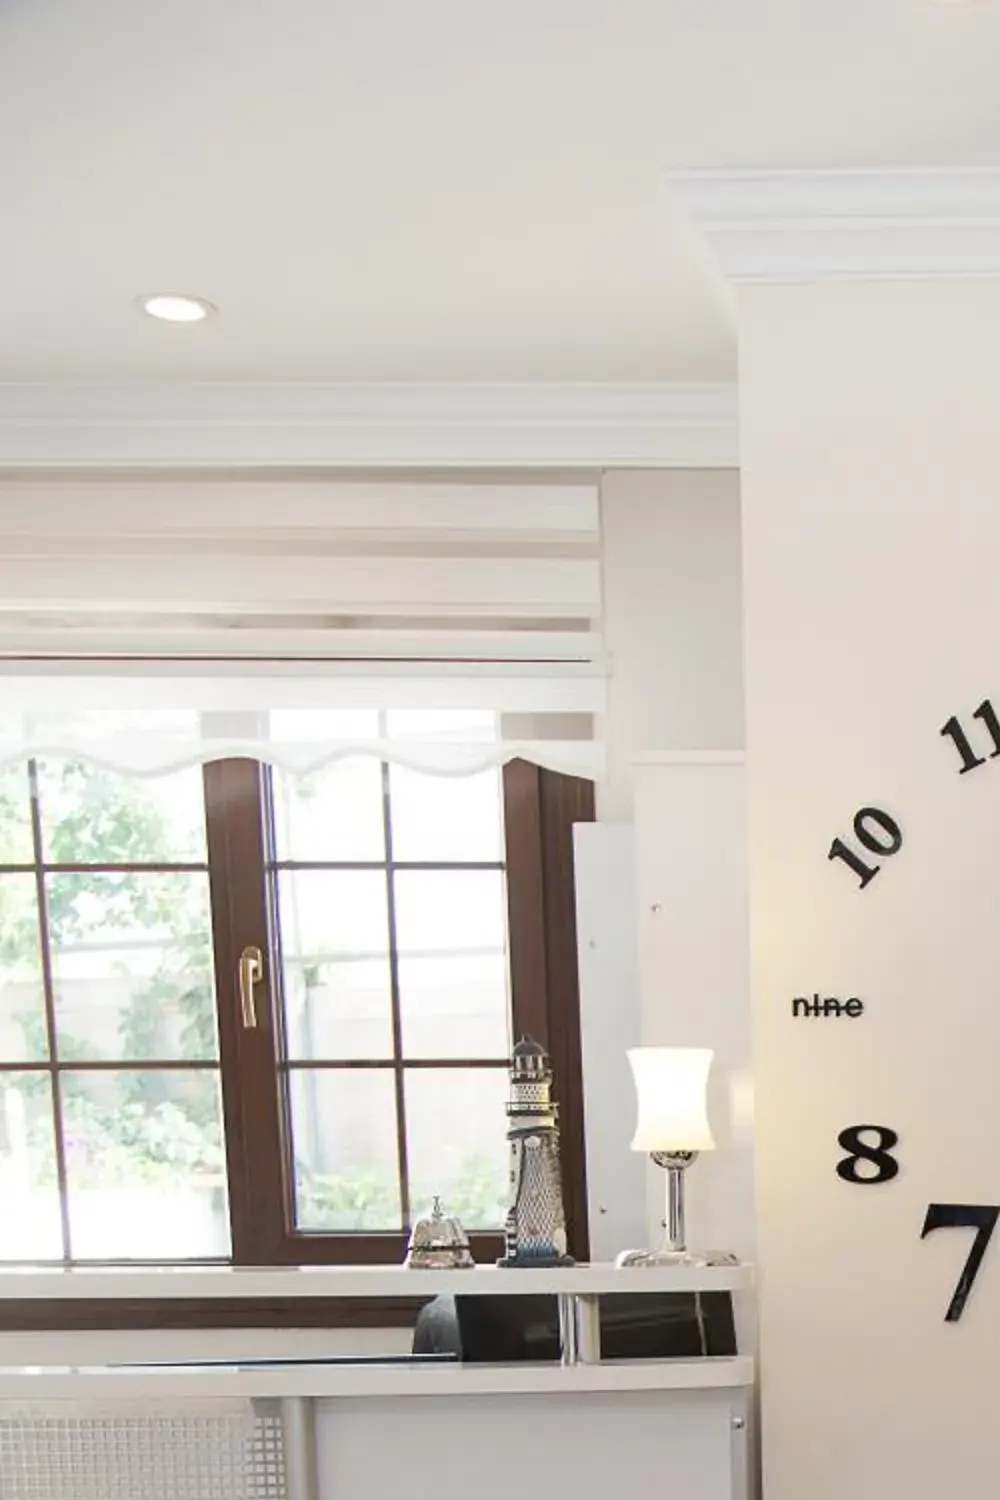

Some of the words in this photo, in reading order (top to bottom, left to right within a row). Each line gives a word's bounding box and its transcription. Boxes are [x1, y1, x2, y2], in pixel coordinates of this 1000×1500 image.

[827, 807, 903, 890] 10
[792, 993, 864, 1018] nine
[835, 1124, 900, 1185] 8
